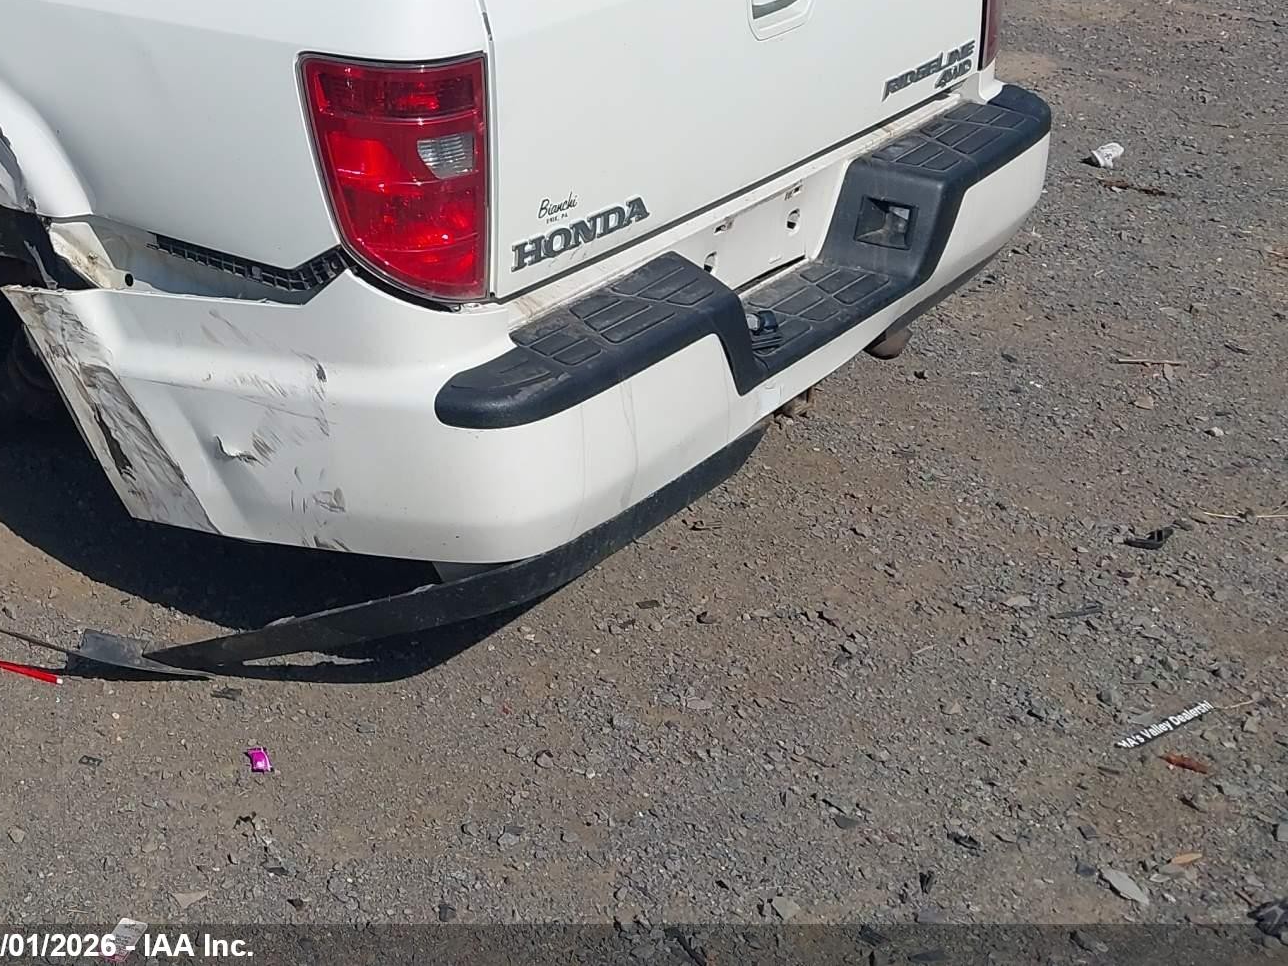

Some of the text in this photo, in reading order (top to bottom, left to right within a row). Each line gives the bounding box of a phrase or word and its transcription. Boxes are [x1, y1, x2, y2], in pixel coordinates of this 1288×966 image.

[881, 39, 976, 102] RIDGELINE
[934, 58, 972, 89] 4WD
[538, 190, 578, 219] Bianchi
[511, 196, 650, 273] HONDA
[1140, 720, 1174, 739] Valley
